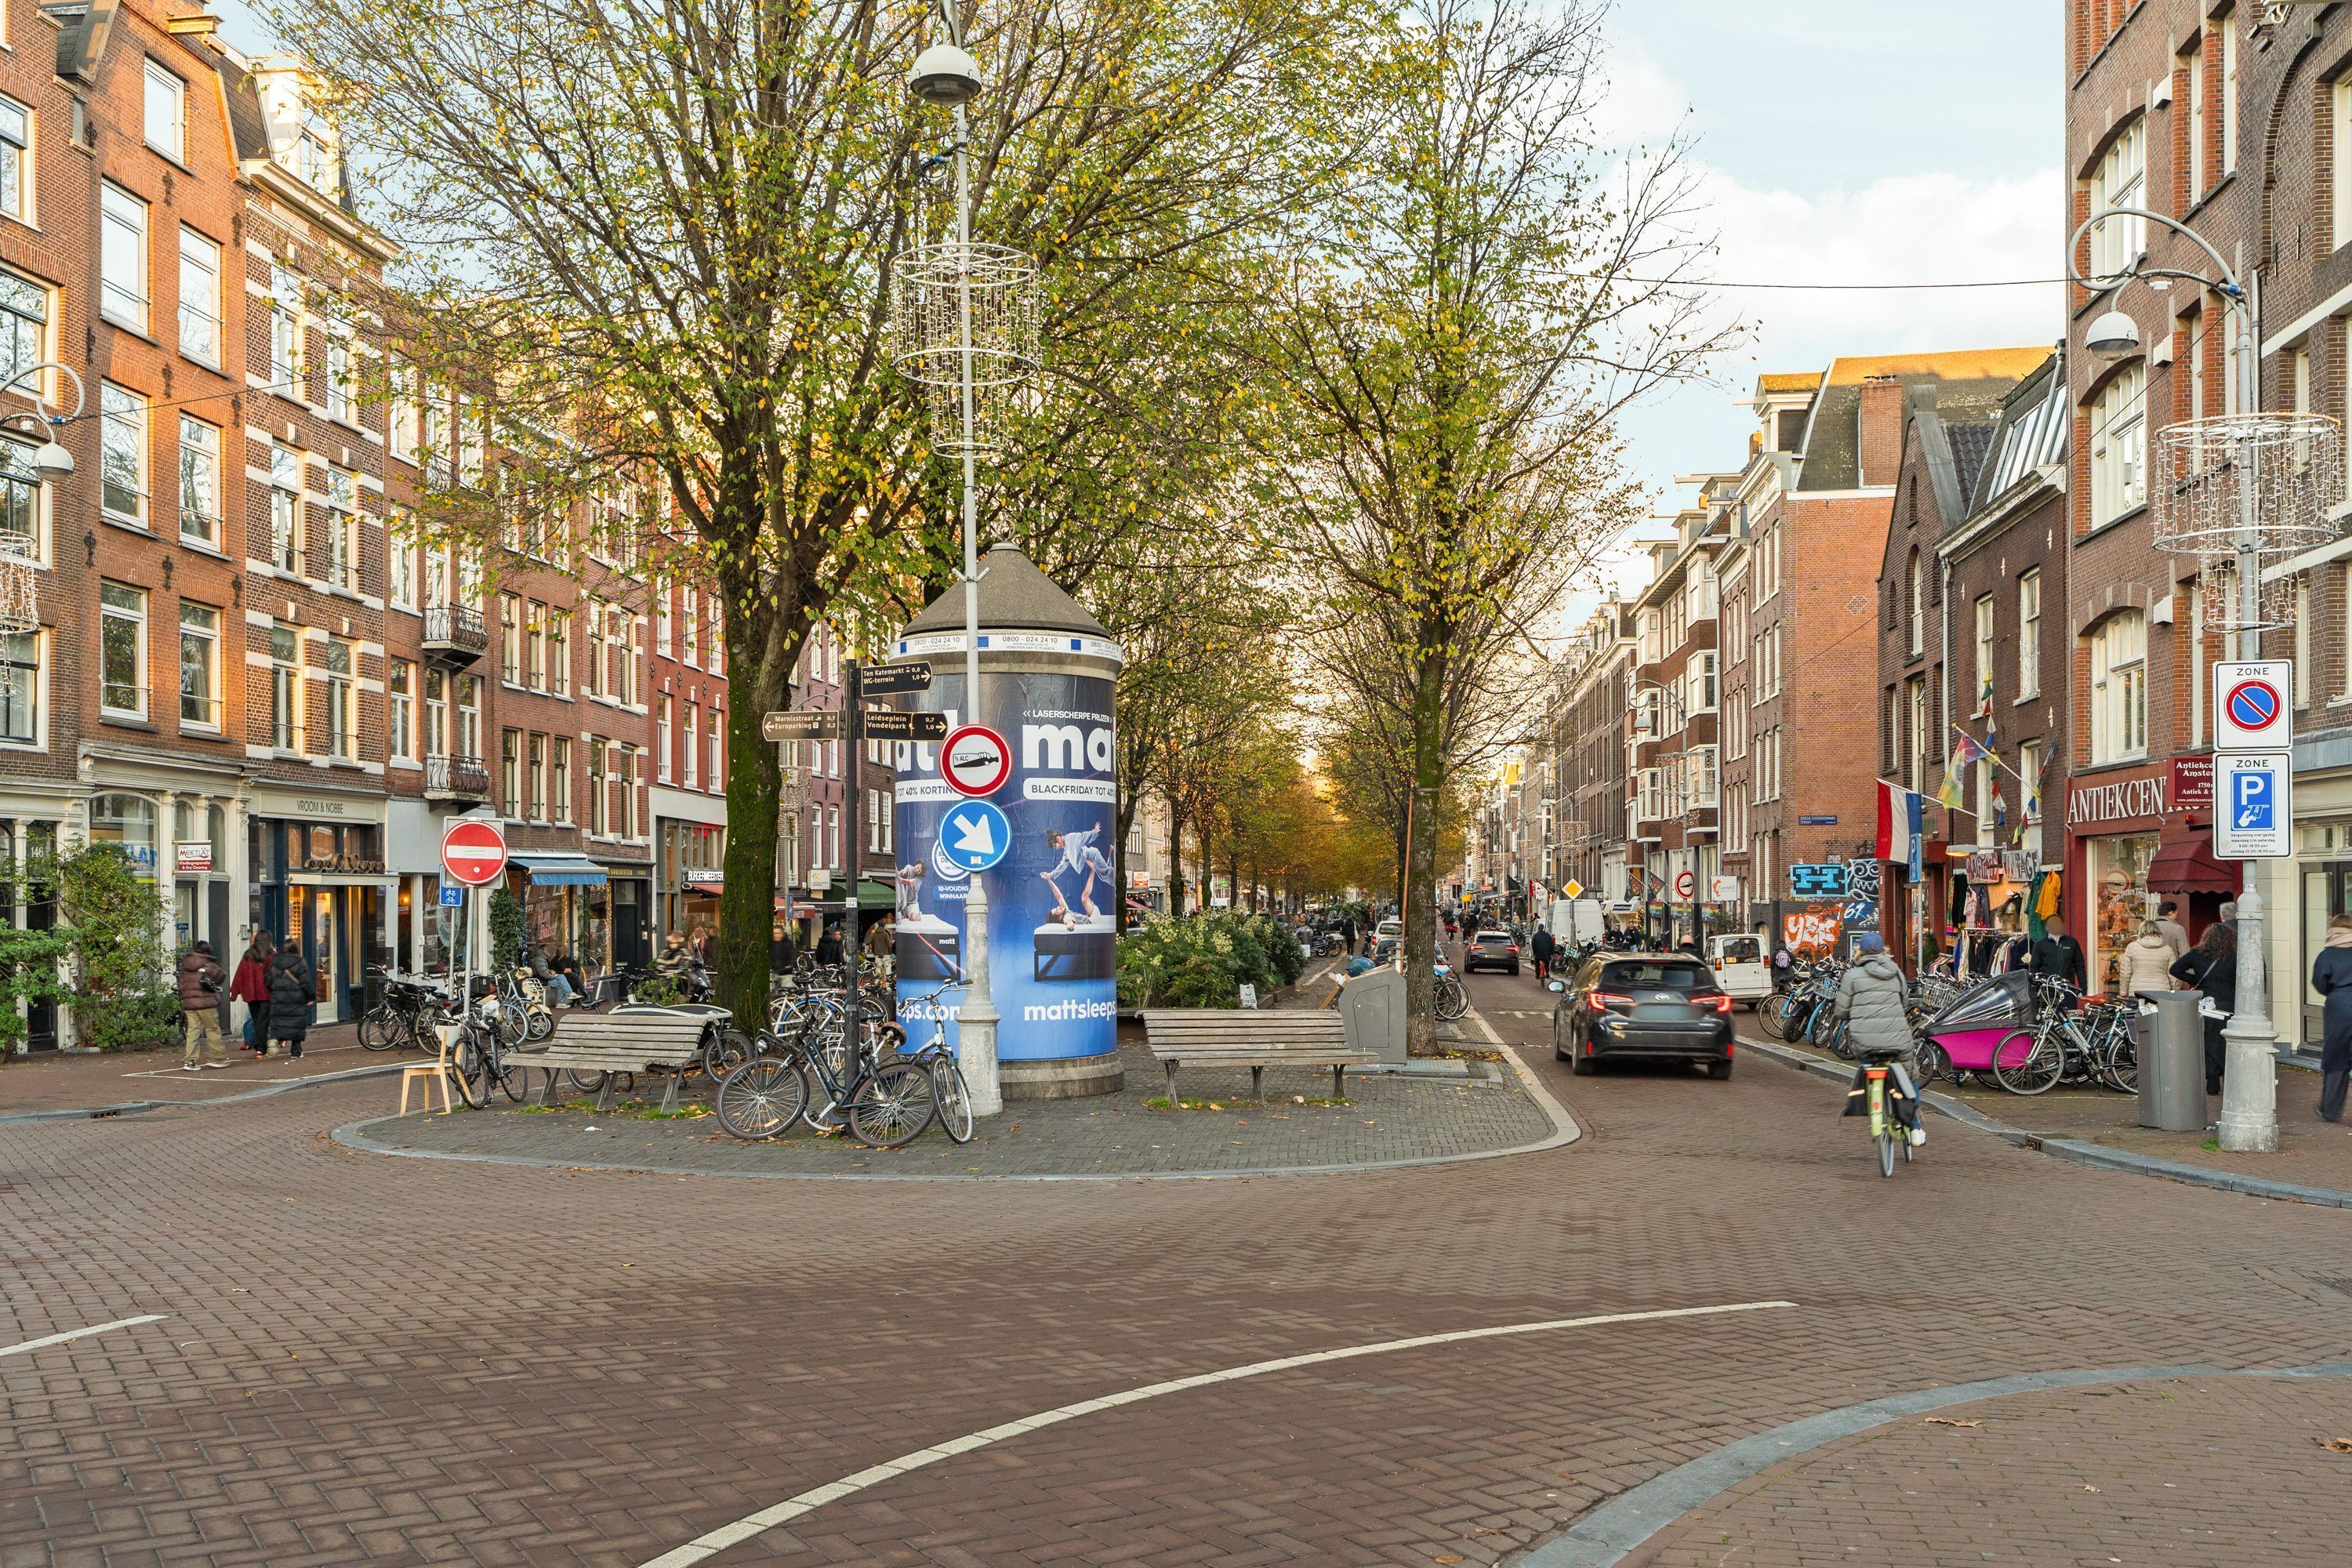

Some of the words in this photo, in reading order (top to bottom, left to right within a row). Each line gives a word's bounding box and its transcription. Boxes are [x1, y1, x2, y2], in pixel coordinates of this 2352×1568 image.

[2236, 667, 2269, 676] ZONE
[1033, 710, 1091, 720] LASERSCHERPE
[1091, 713, 1110, 721] PRIJZEN
[906, 787, 918, 796] 40%
[1031, 785, 1094, 795] BLACKFRIDAY
[1095, 787, 1106, 796] TOT
[2241, 775, 2264, 806] P
[296, 800, 319, 812] VROOM
[320, 803, 325, 812] &
[325, 803, 344, 815] NOBBE
[31, 846, 44, 858] 146
